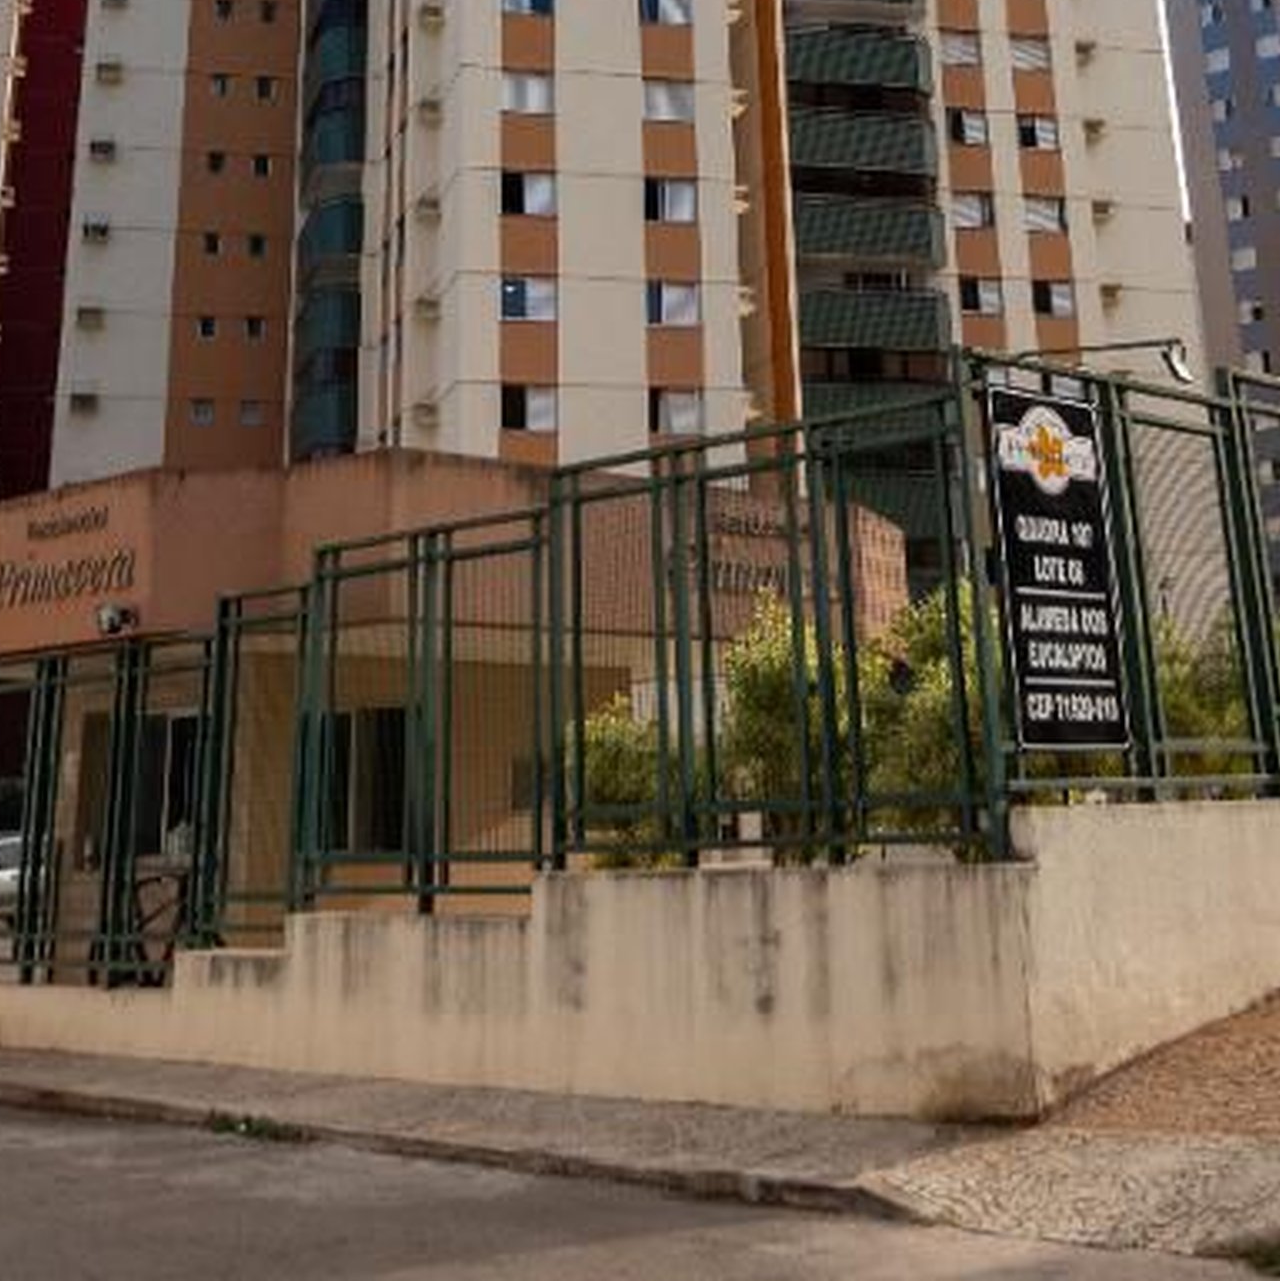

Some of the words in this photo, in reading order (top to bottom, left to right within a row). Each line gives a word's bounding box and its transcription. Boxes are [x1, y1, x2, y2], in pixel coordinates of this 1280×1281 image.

[1033, 554, 1067, 584] LOTE
[1021, 603, 1079, 634] ALAMEDA
[1080, 606, 1108, 636] DOS
